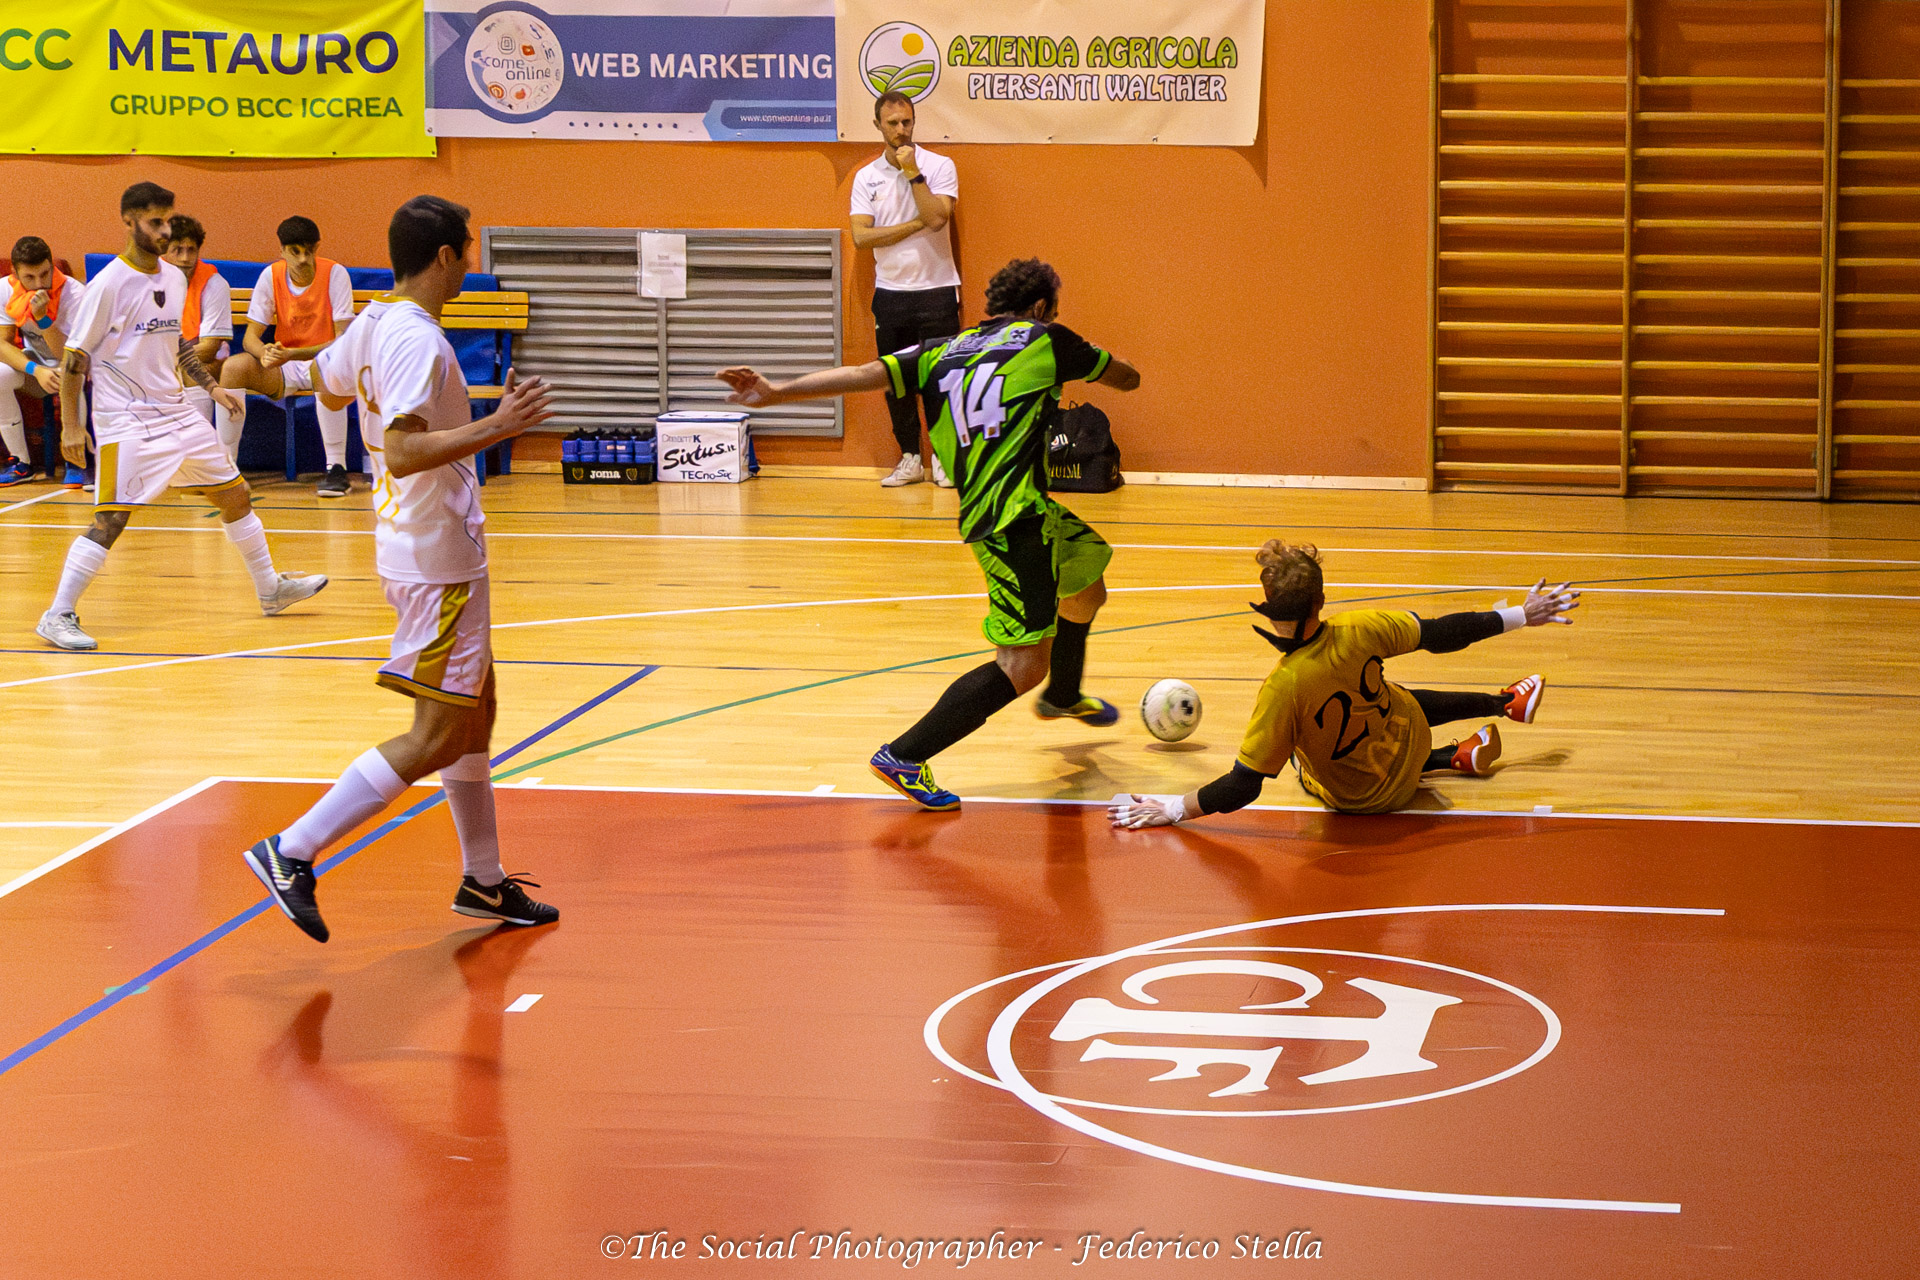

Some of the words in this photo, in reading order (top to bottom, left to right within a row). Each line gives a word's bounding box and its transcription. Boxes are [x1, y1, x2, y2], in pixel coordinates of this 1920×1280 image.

[108, 28, 399, 75] METAURO
[571, 52, 641, 78] WEB
[650, 52, 833, 79] MARKETING
[947, 35, 1079, 68] AZIENDA
[1086, 36, 1238, 69] AGRICOLA
[506, 66, 551, 80] online
[968, 73, 1099, 101] PIERSANTI
[1105, 74, 1227, 102] WALTHER
[110, 95, 229, 117] GRUPPO
[237, 97, 293, 118] BCC
[302, 97, 404, 118] ICCREA
[938, 361, 1007, 448] 14
[1314, 655, 1391, 761] 29
